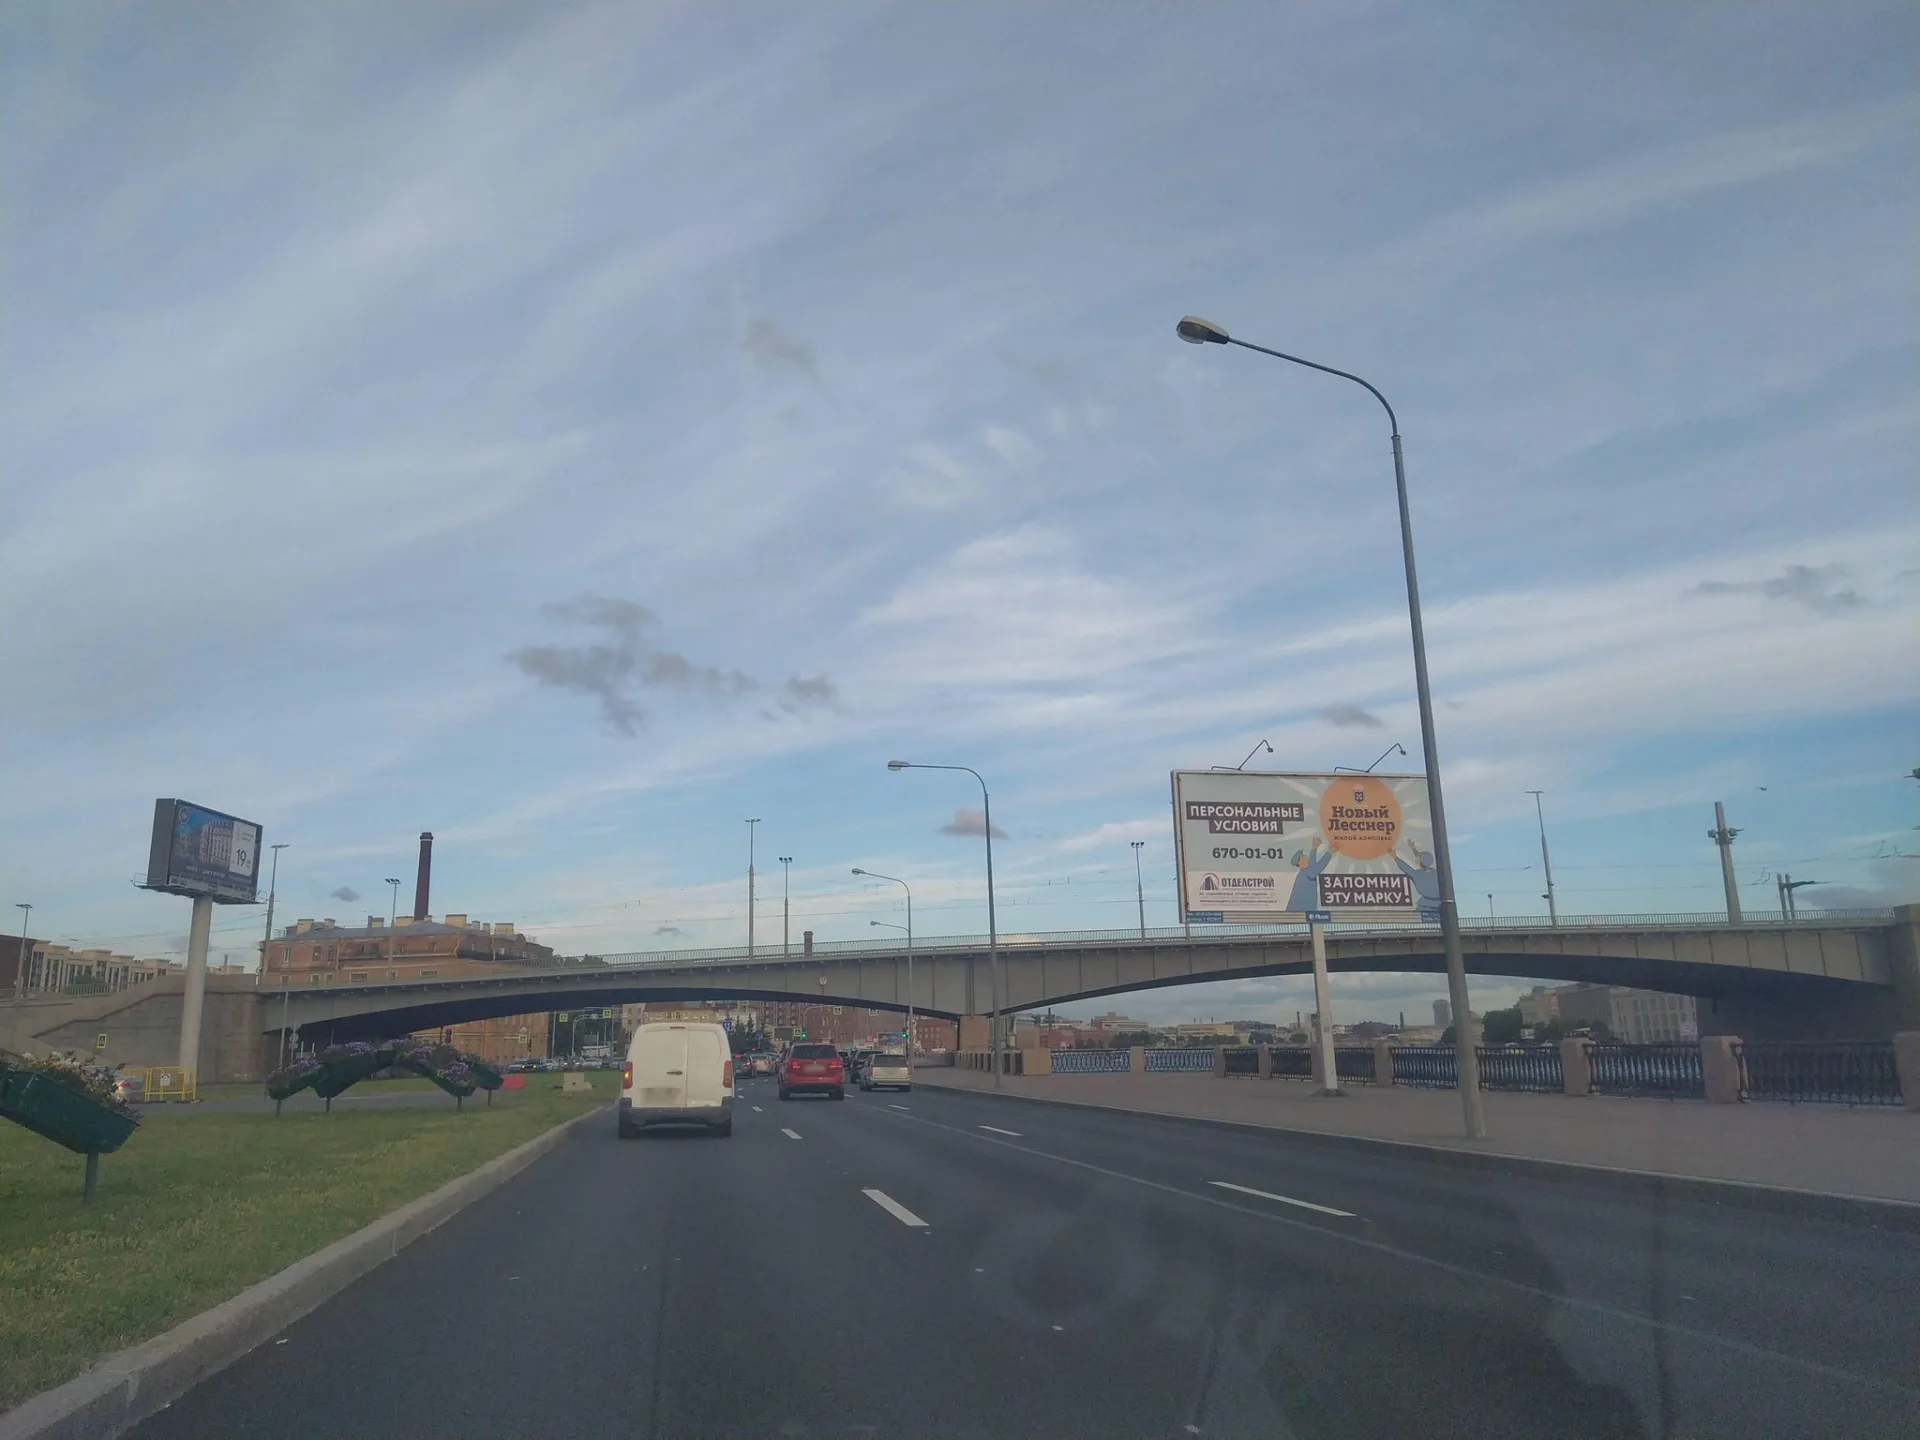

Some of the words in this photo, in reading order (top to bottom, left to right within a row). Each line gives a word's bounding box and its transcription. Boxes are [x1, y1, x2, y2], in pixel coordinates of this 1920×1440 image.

[1190, 805, 1300, 818] ПЕРСОНАЛЬНЫЕ
[1331, 805, 1389, 818] Новый
[1214, 820, 1278, 832] УСЛОВИЯ
[1328, 819, 1396, 835] Лесснер
[1212, 847, 1284, 859] 670-01-01
[1221, 876, 1275, 887] ОТДЕЛСТРОЙ
[1324, 876, 1401, 888] ЗАПОМНИ
[1325, 892, 1351, 904] ЭТУ
